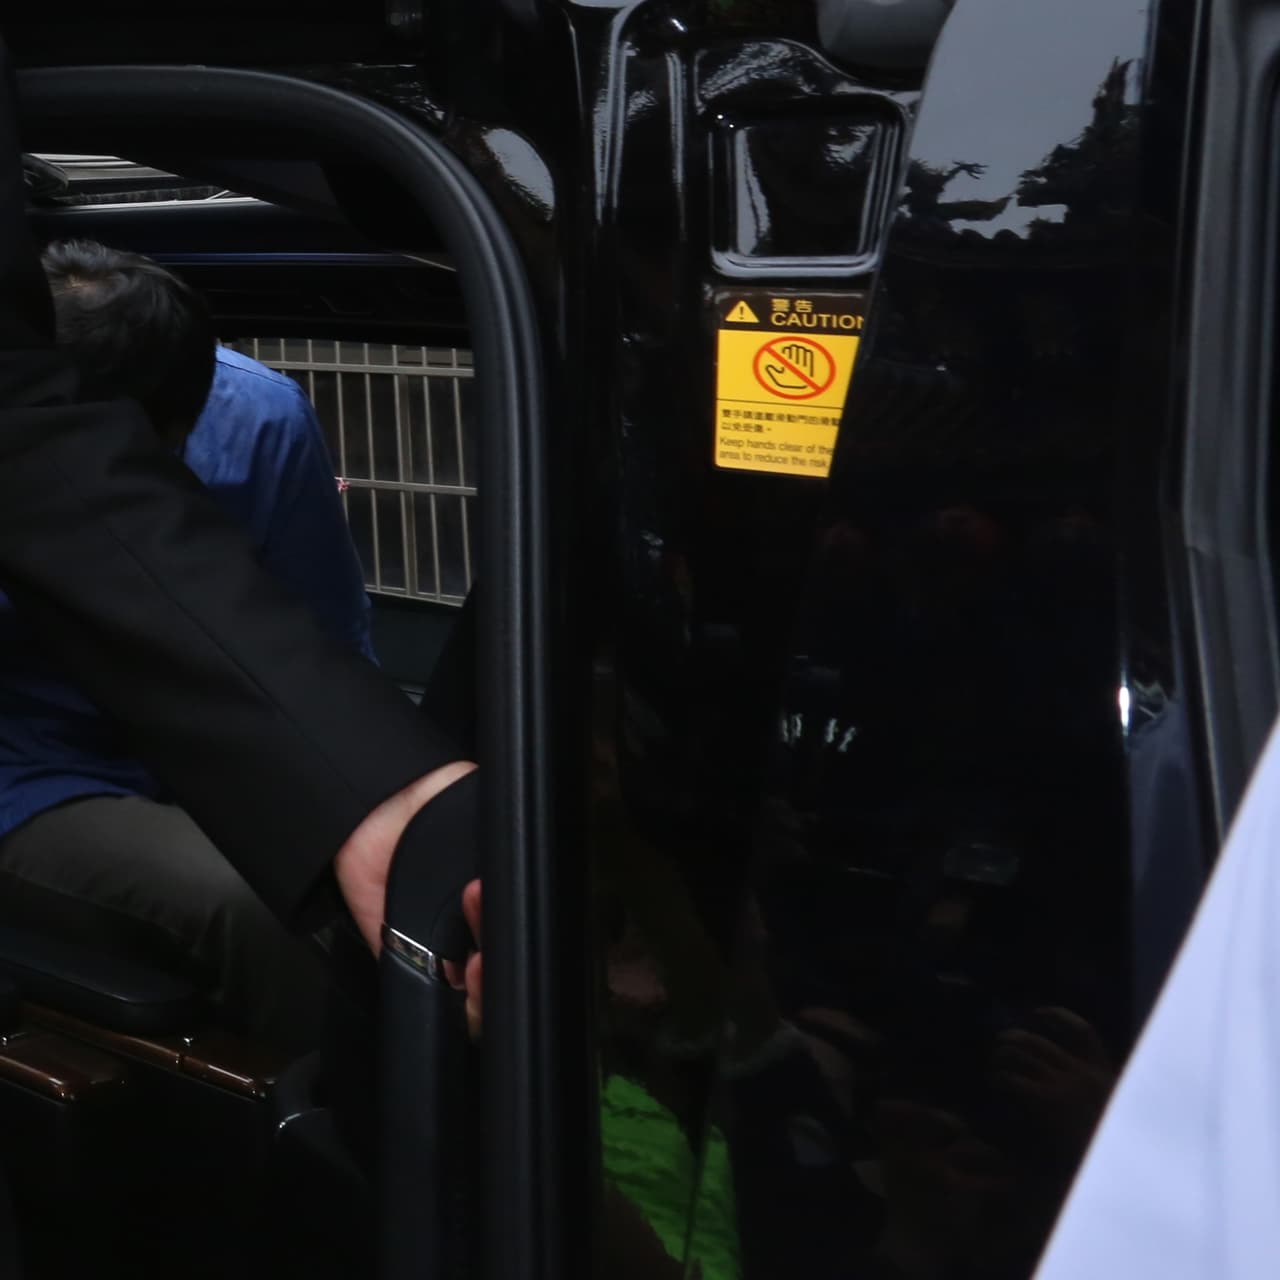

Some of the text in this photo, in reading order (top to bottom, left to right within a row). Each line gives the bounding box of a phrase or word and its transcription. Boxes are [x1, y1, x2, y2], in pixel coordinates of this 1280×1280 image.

[720, 436, 744, 448] Keep
[747, 438, 776, 450] hands
[779, 441, 802, 452] clear
[806, 444, 816, 453] of
[743, 451, 752, 460] to
[755, 453, 788, 464] reduce
[791, 456, 807, 466] the
[809, 458, 826, 468] risk
